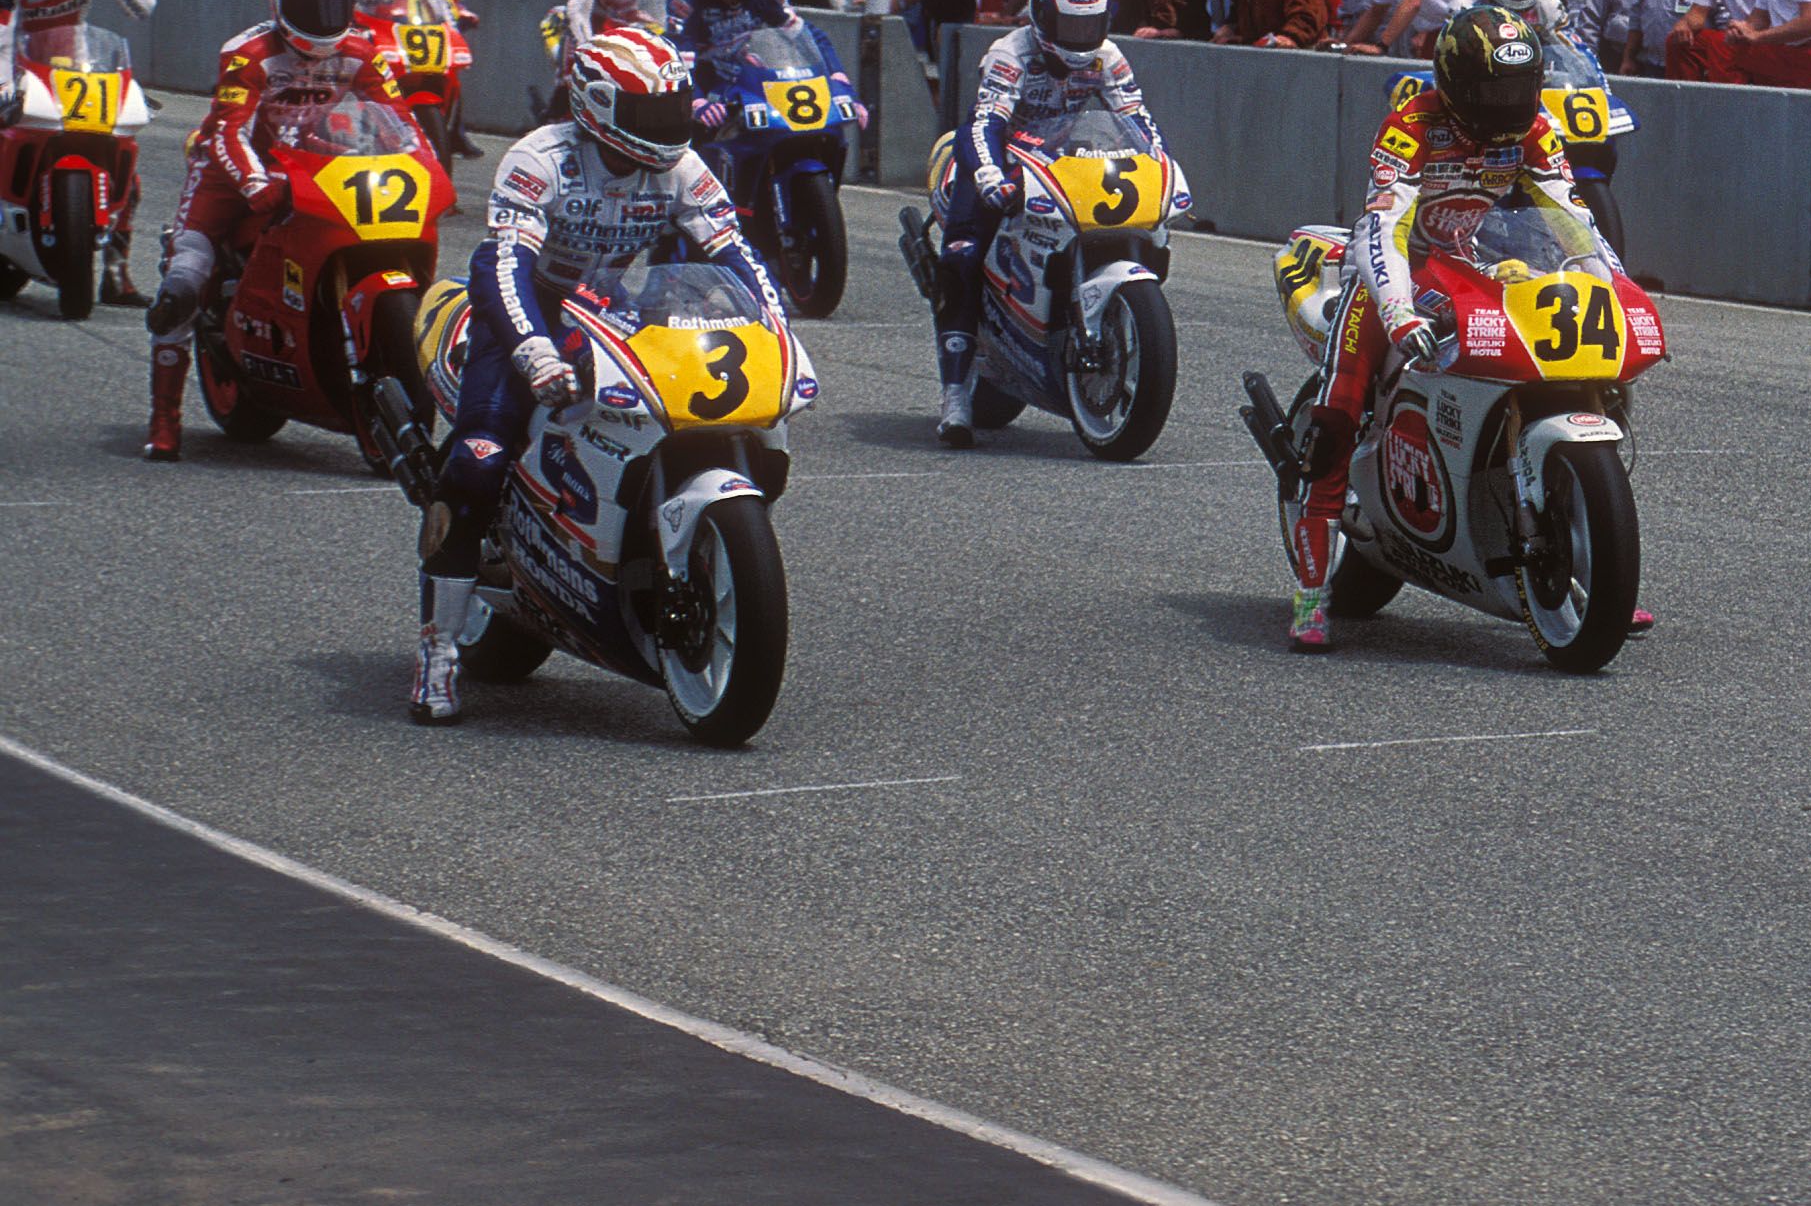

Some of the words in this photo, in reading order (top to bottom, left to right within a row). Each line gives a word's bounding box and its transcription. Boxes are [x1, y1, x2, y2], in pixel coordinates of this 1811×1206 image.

[405, 28, 446, 66] 97
[1496, 43, 1532, 61] Arai
[64, 77, 109, 125] 21
[786, 85, 823, 125] 8
[1563, 93, 1602, 139] 6
[343, 168, 420, 226] 12
[565, 198, 602, 217] elf
[1092, 158, 1140, 226] 5
[1432, 205, 1482, 221] LUCKY
[1369, 213, 1390, 288] SUZUKI
[496, 228, 534, 335] Rothmans
[668, 315, 750, 329] Rothmans
[1344, 306, 1366, 355] TAICHI
[1467, 327, 1507, 338] STRIKE
[1468, 316, 1507, 327] LUCKY
[1534, 282, 1620, 362] 34
[1628, 316, 1655, 326] LUCKY
[1632, 326, 1660, 337] STRIKE
[1466, 340, 1505, 348] SUZUKI
[688, 329, 750, 420] 3
[600, 410, 648, 432] elf
[1436, 413, 1462, 430] STRIKE
[1437, 399, 1462, 420] LUCKY
[579, 424, 632, 462] NSR
[1388, 427, 1431, 482] LUCKY
[1390, 462, 1441, 513] STRIE
